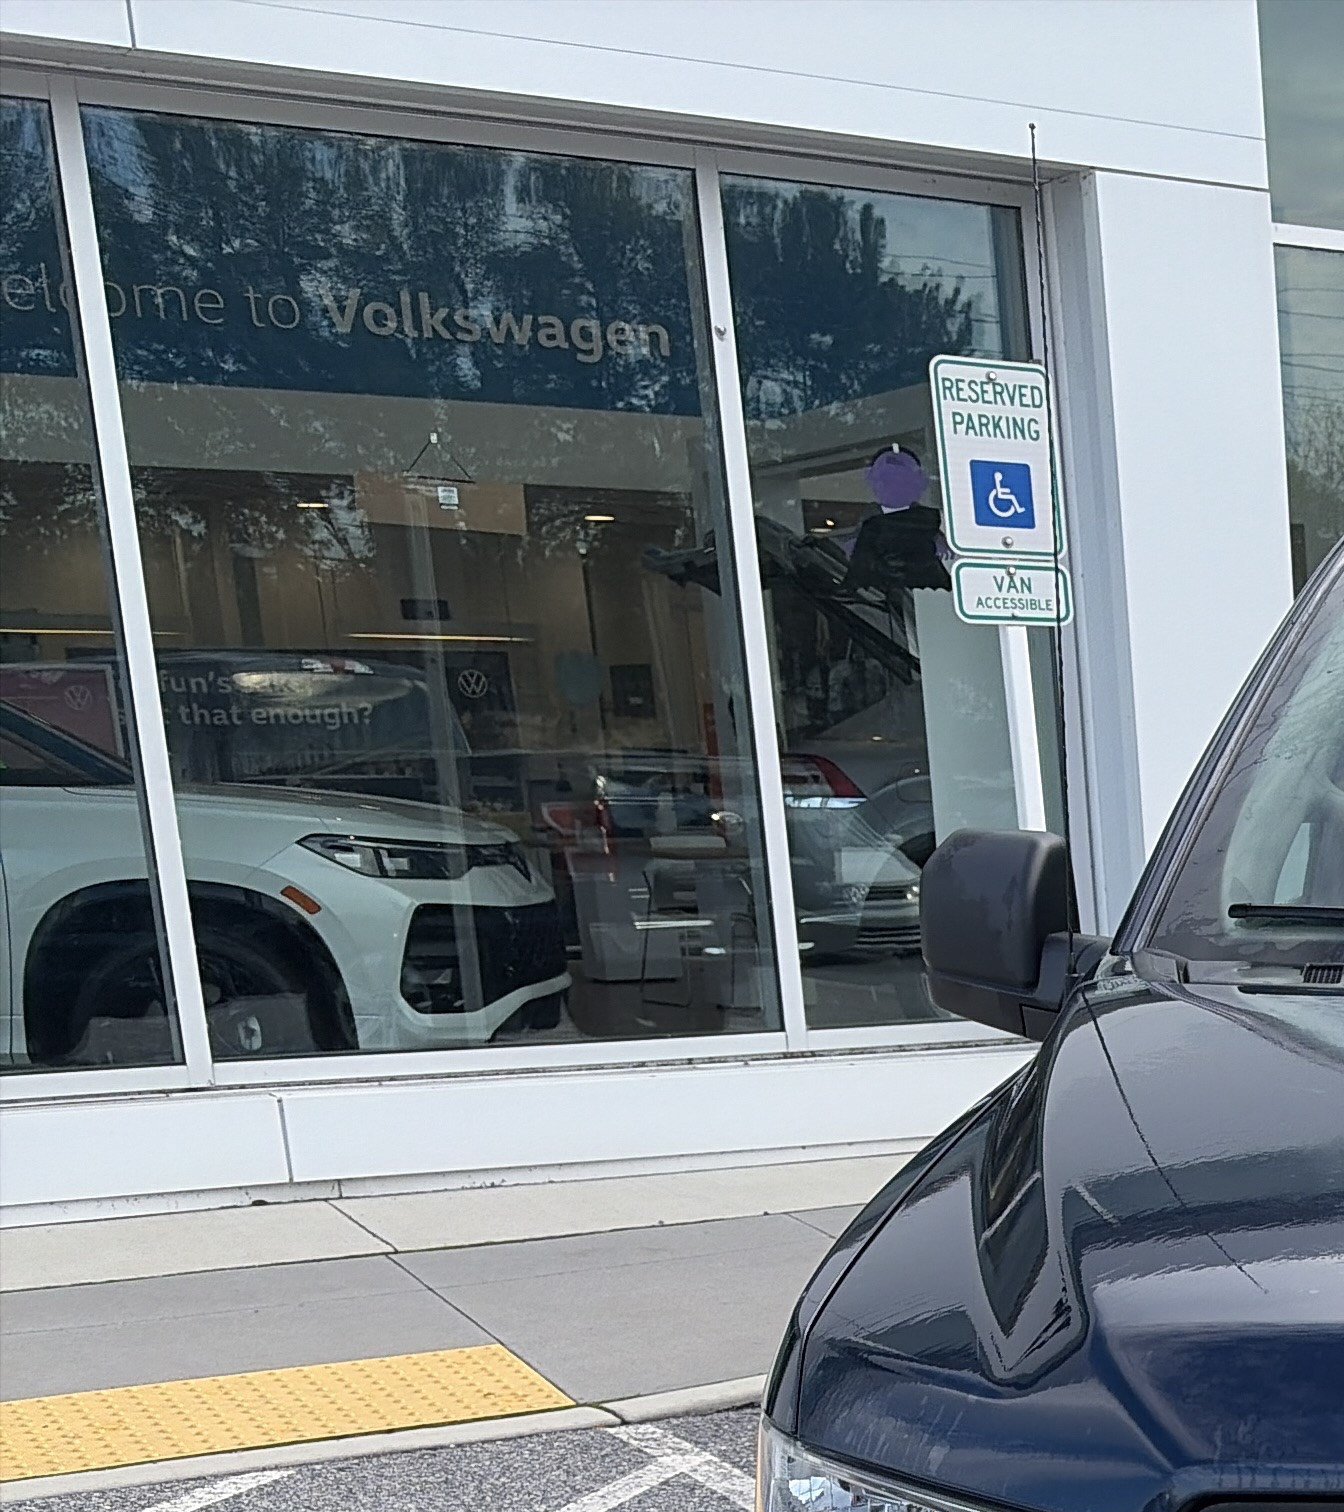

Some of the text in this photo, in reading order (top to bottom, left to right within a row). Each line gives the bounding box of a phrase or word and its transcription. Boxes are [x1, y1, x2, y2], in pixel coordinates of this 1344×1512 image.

[244, 286, 299, 329] to
[318, 285, 671, 364] Volkswagen
[941, 376, 1044, 409] RESERVED
[952, 411, 1041, 442] PARKING
[993, 575, 1033, 594] VAN
[976, 596, 1054, 612] ACCESSIBLE
[179, 702, 242, 726] that
[251, 701, 373, 730] enough?
